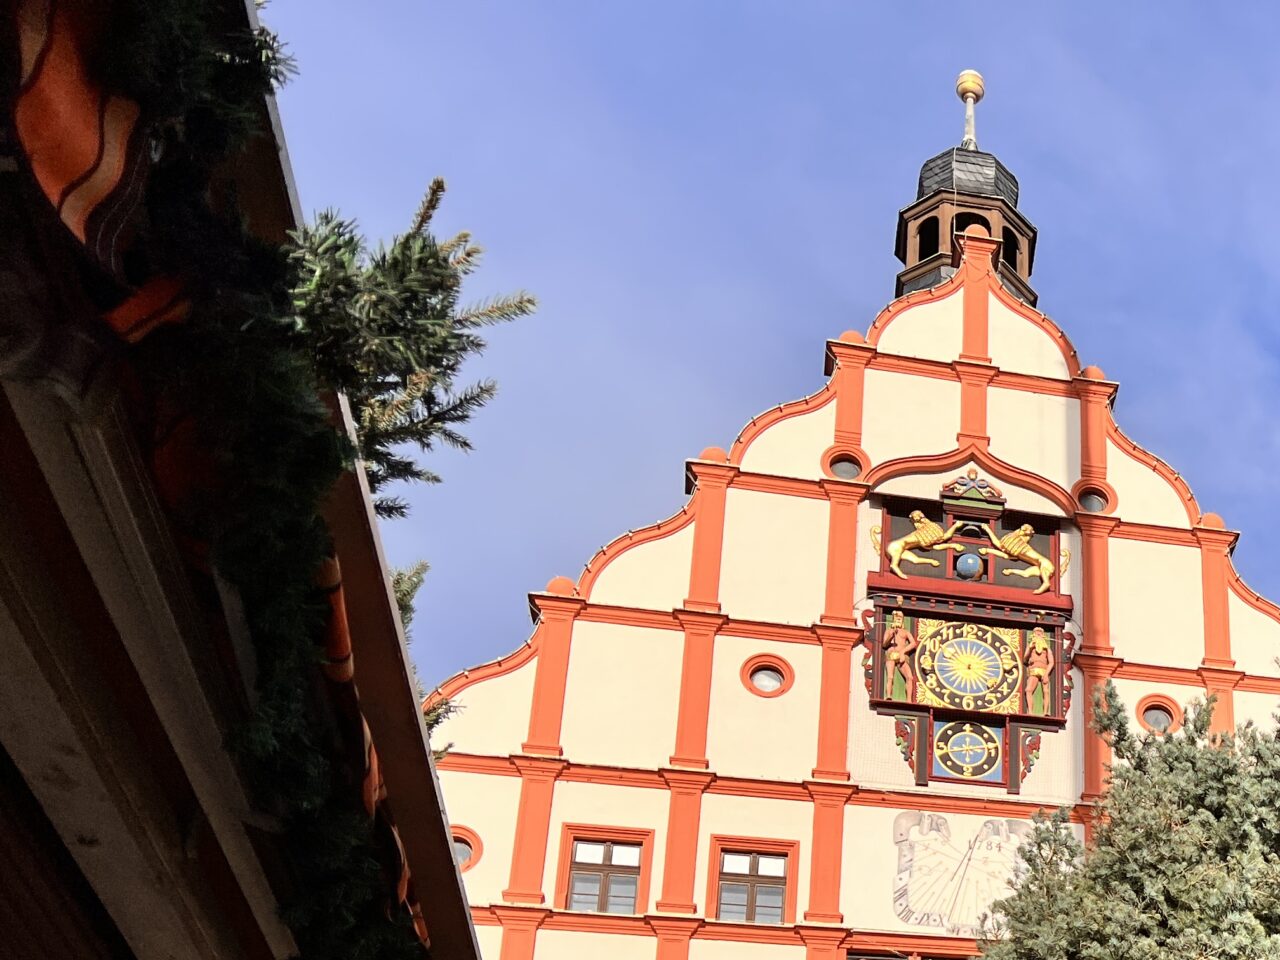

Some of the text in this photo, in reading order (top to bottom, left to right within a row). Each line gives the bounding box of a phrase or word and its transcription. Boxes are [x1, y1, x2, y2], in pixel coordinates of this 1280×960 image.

[940, 626, 954, 640] 11
[959, 623, 978, 639] 12
[983, 631, 992, 644] 1
[924, 638, 940, 653] 10
[926, 673, 937, 688] 8
[998, 681, 1011, 695] 4
[941, 689, 951, 703] 7
[962, 696, 975, 710] 6
[984, 693, 998, 707] 5
[962, 723, 973, 733] 4
